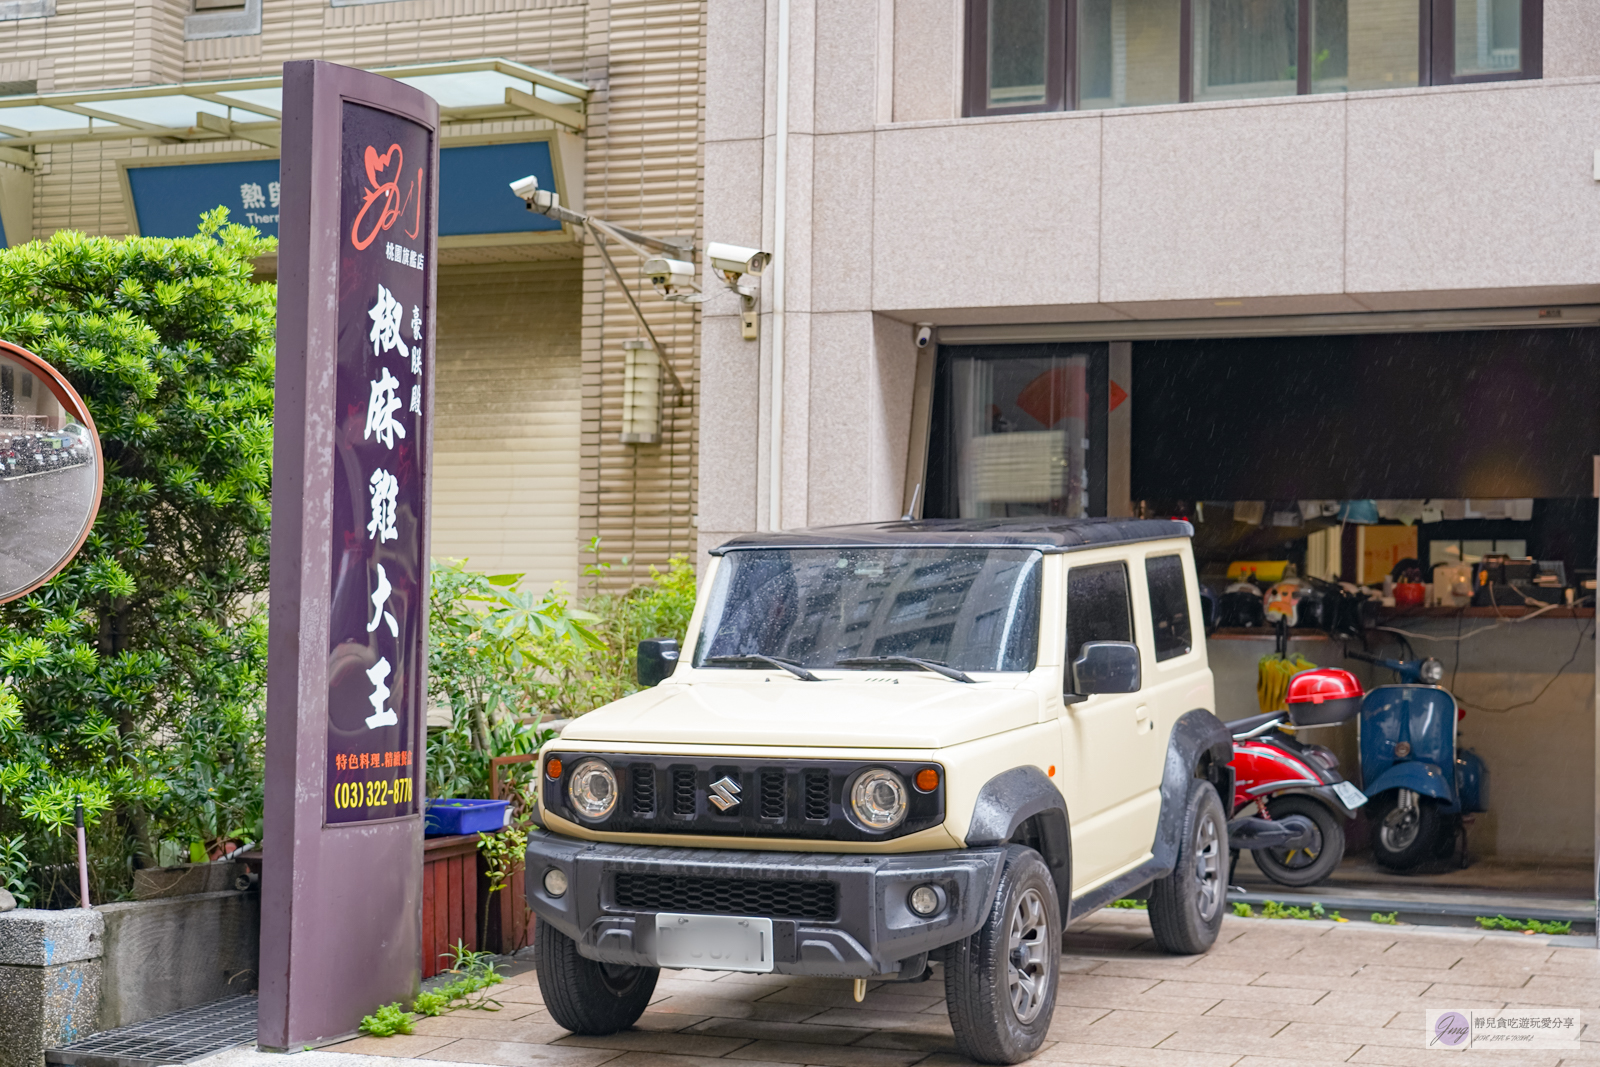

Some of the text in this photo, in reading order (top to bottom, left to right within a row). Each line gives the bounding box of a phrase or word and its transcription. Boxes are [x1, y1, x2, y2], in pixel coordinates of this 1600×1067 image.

[364, 283, 409, 730] 椒麻雞大王
